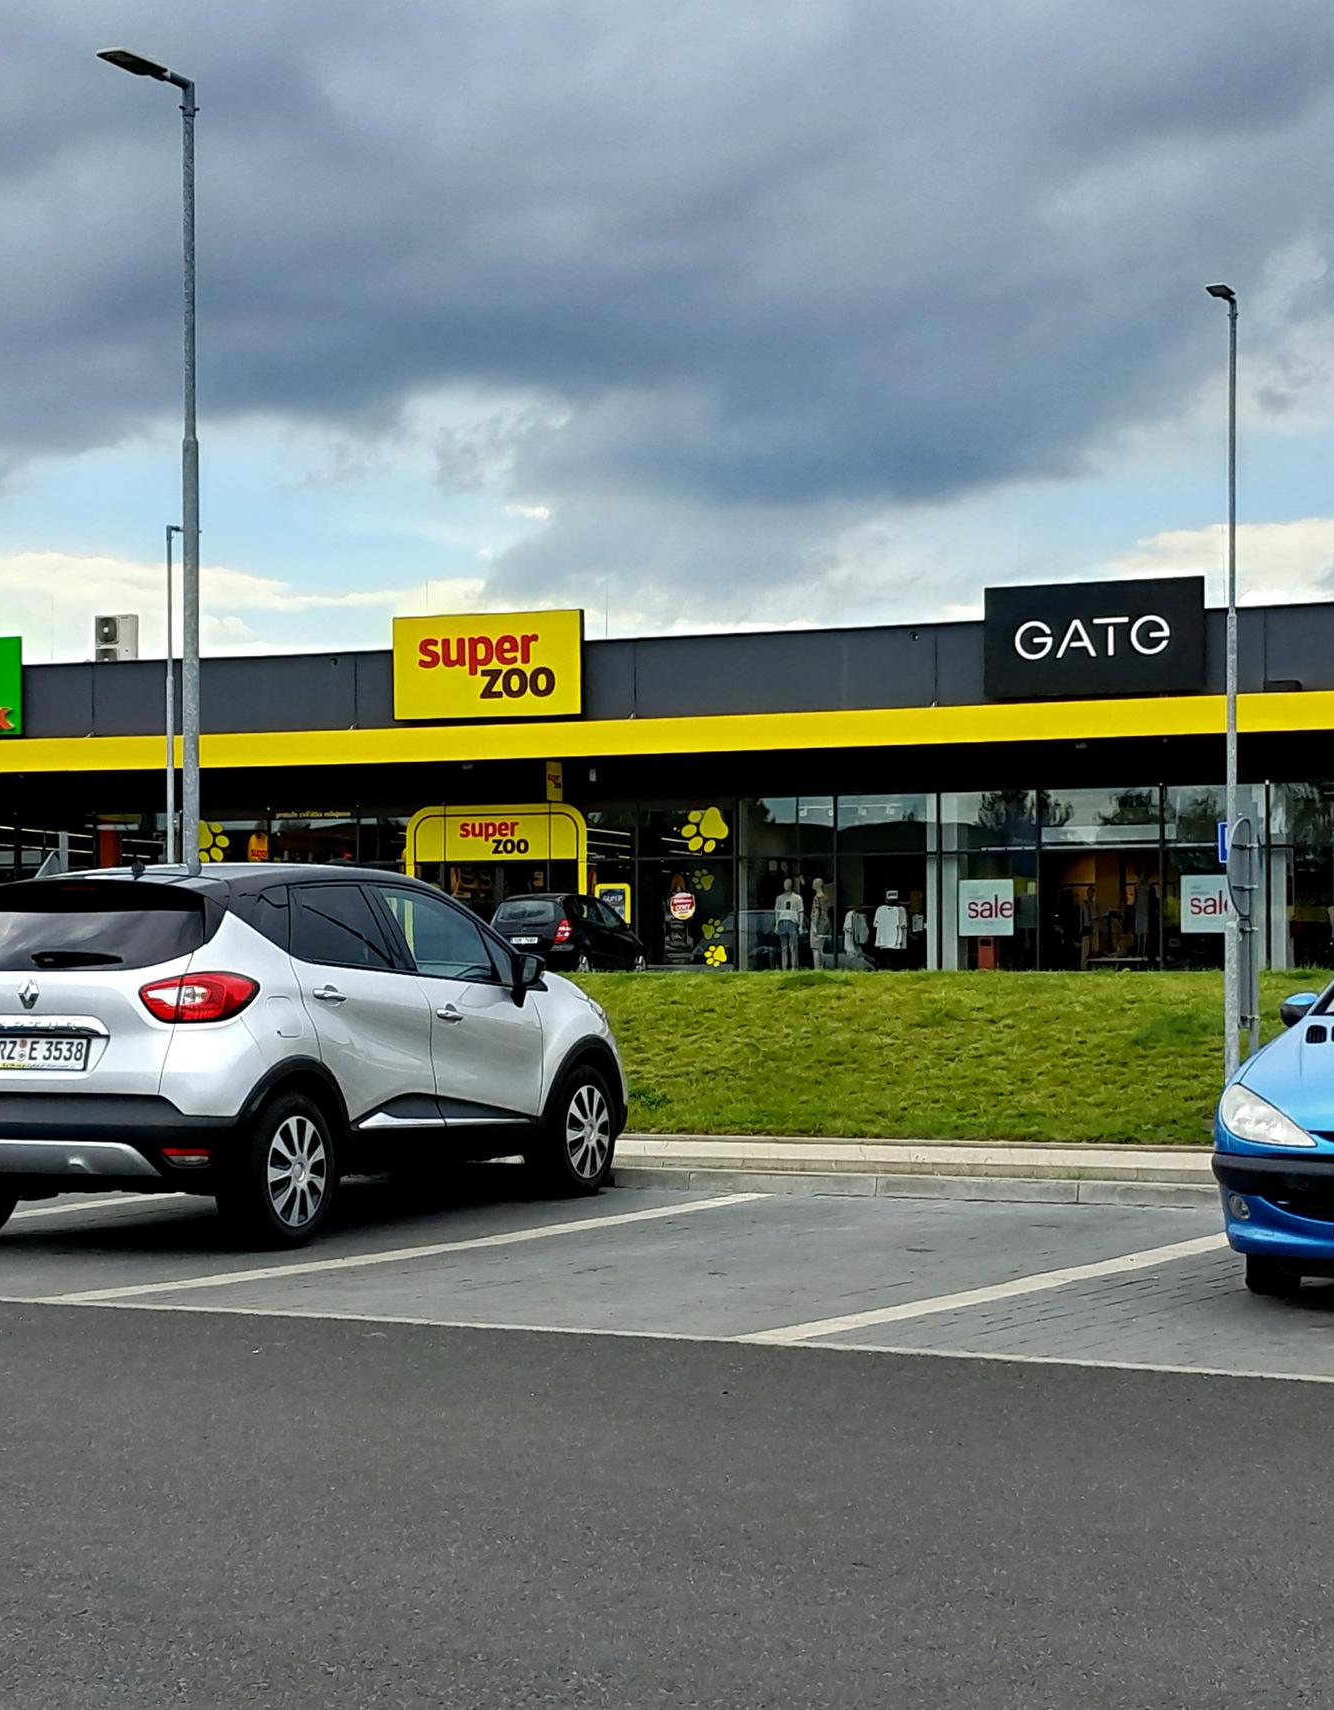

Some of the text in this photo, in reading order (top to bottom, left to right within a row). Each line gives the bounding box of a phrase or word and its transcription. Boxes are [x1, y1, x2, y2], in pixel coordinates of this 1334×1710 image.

[418, 634, 539, 676] super
[459, 821, 520, 842] super
[968, 894, 1013, 919] sale
[1190, 890, 1227, 915] sal
[28, 1040, 40, 1061] E
[42, 1041, 84, 1062] 3538
